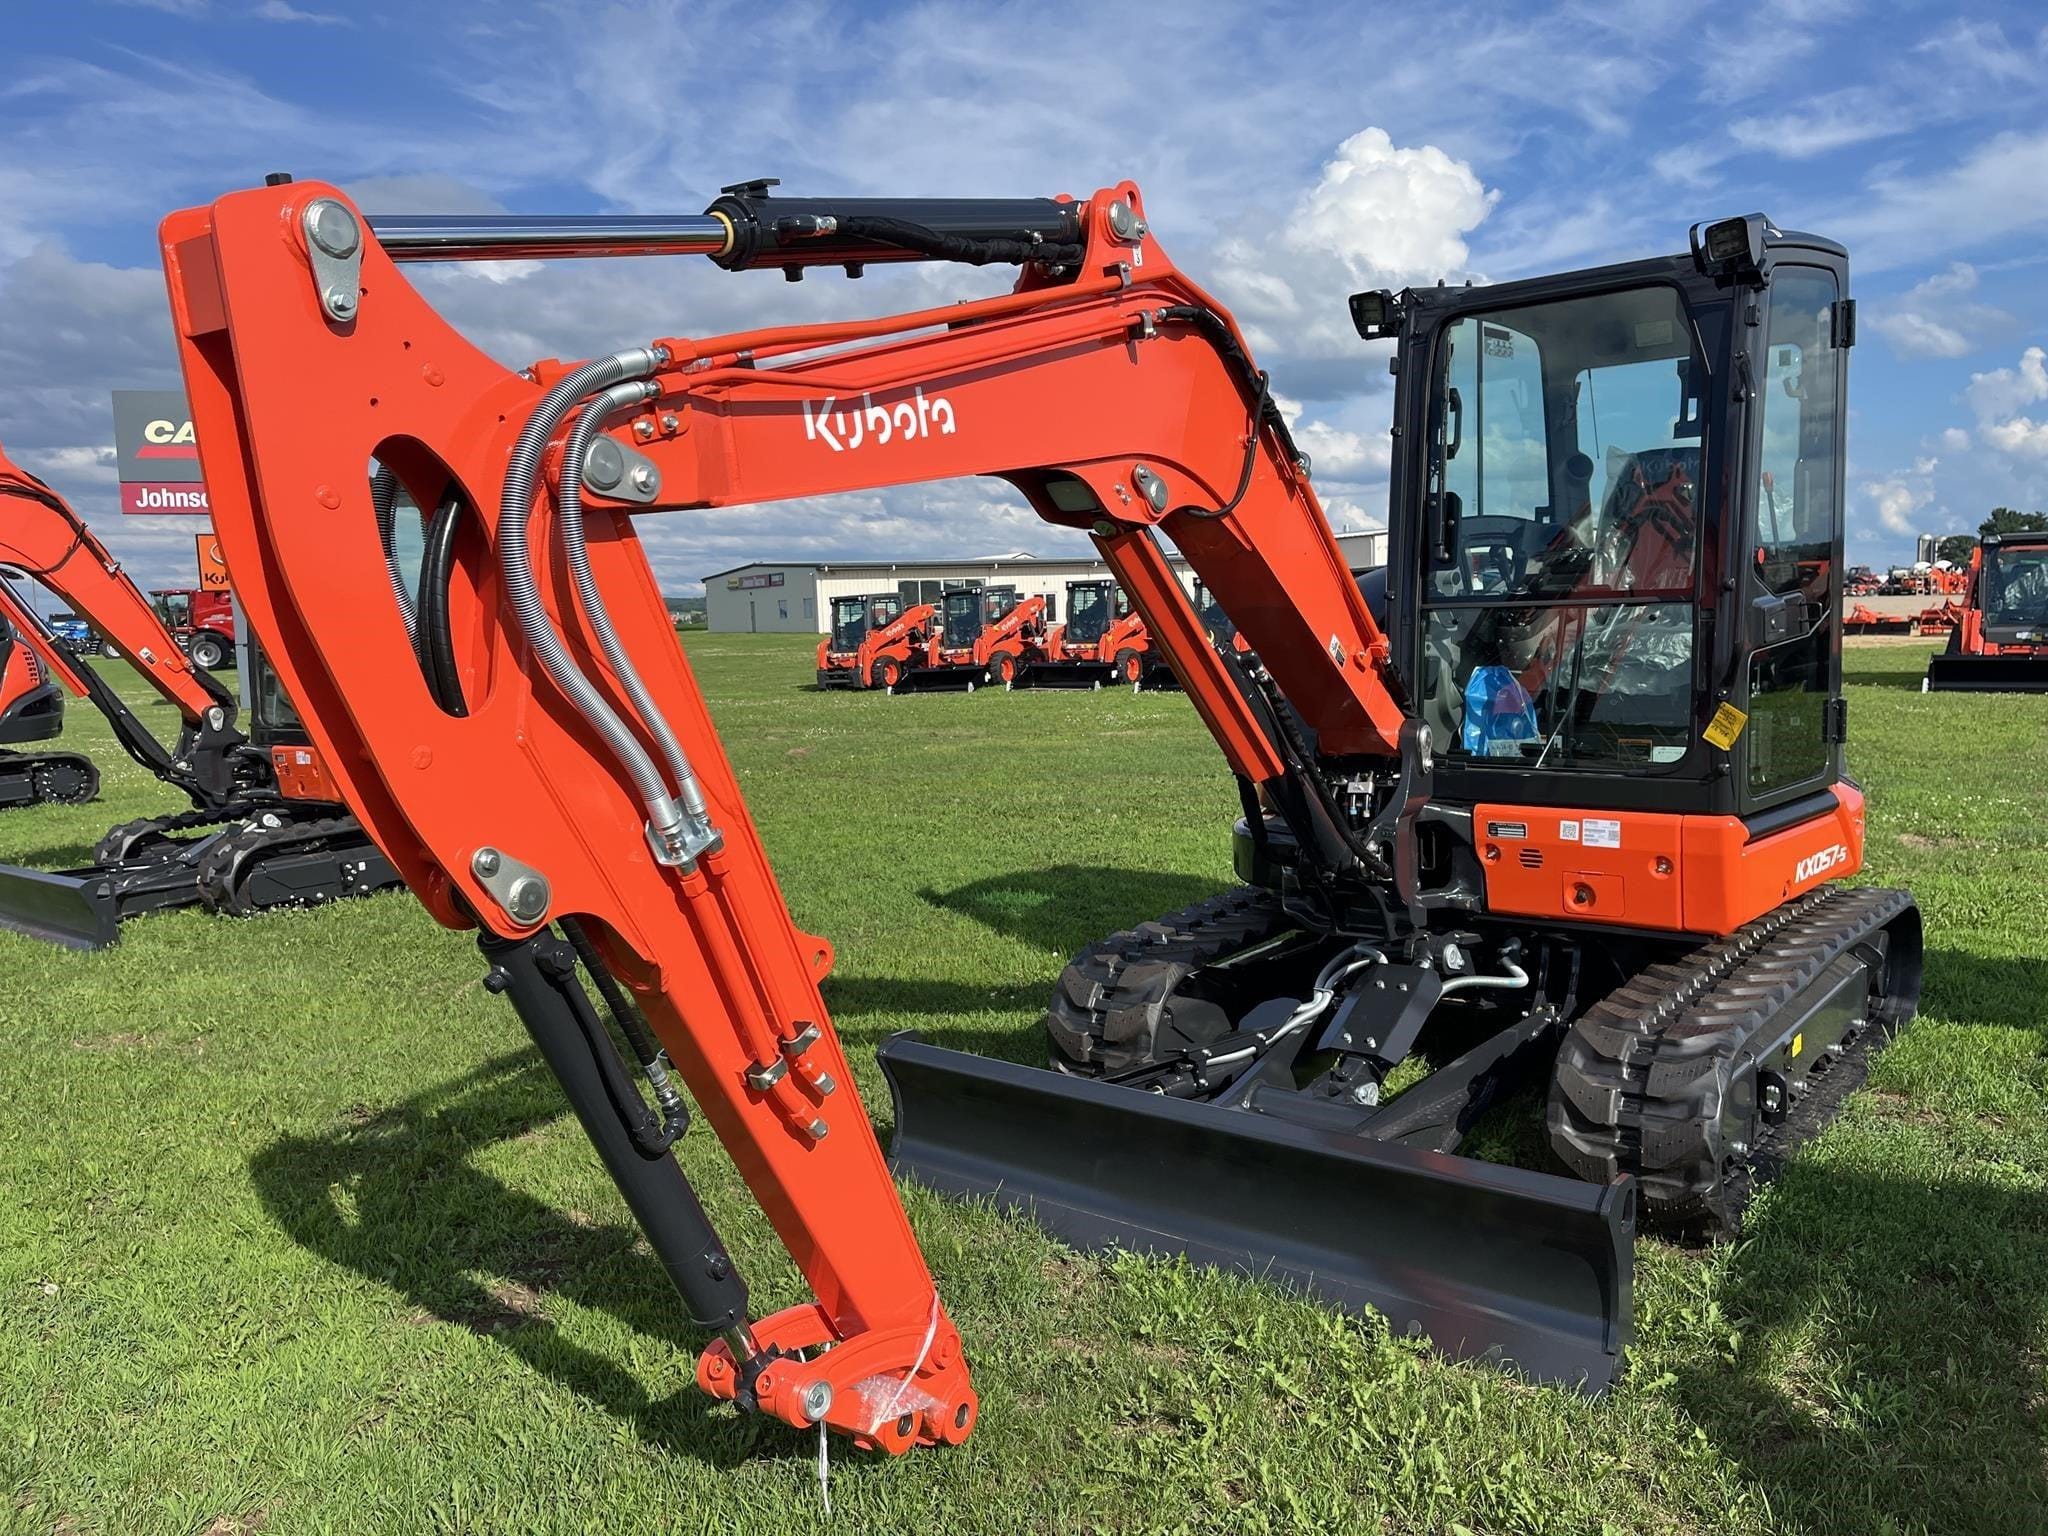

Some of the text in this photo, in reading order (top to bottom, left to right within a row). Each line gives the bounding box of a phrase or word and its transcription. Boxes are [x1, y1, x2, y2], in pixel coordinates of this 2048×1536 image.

[144, 419, 197, 444] CA
[803, 386, 956, 452] Kubota
[135, 487, 209, 508] Johnso
[1794, 843, 1848, 884] KX057-5
